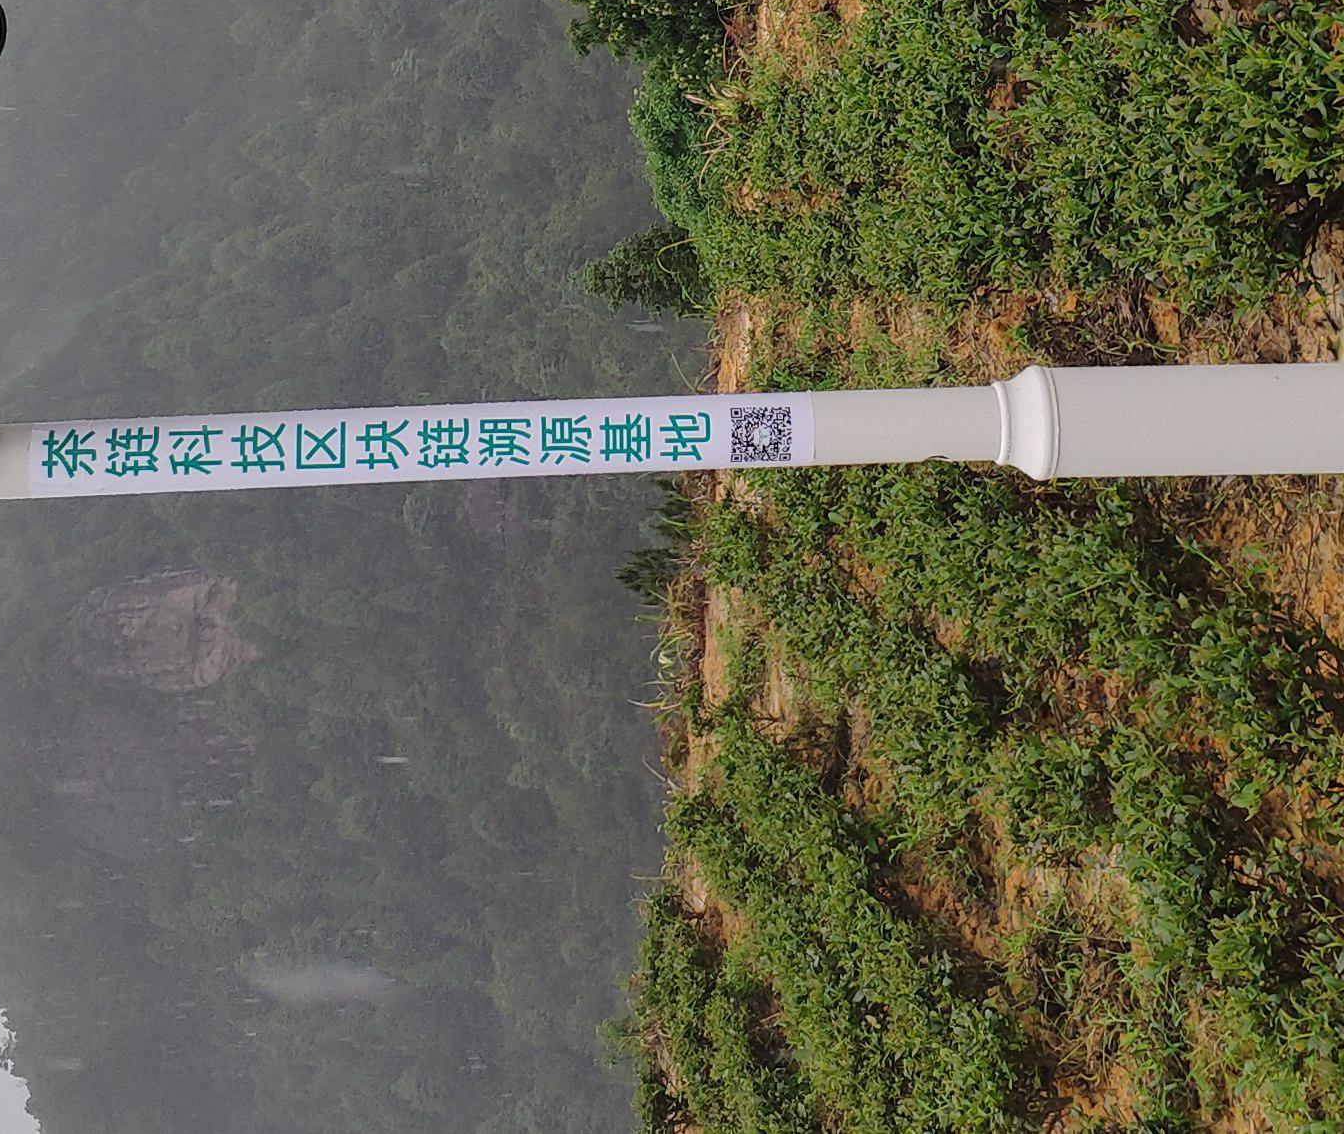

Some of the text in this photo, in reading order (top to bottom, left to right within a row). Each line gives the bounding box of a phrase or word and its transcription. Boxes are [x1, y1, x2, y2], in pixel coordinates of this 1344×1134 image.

[41, 412, 711, 479] 茶链科技区块链溯源基地
